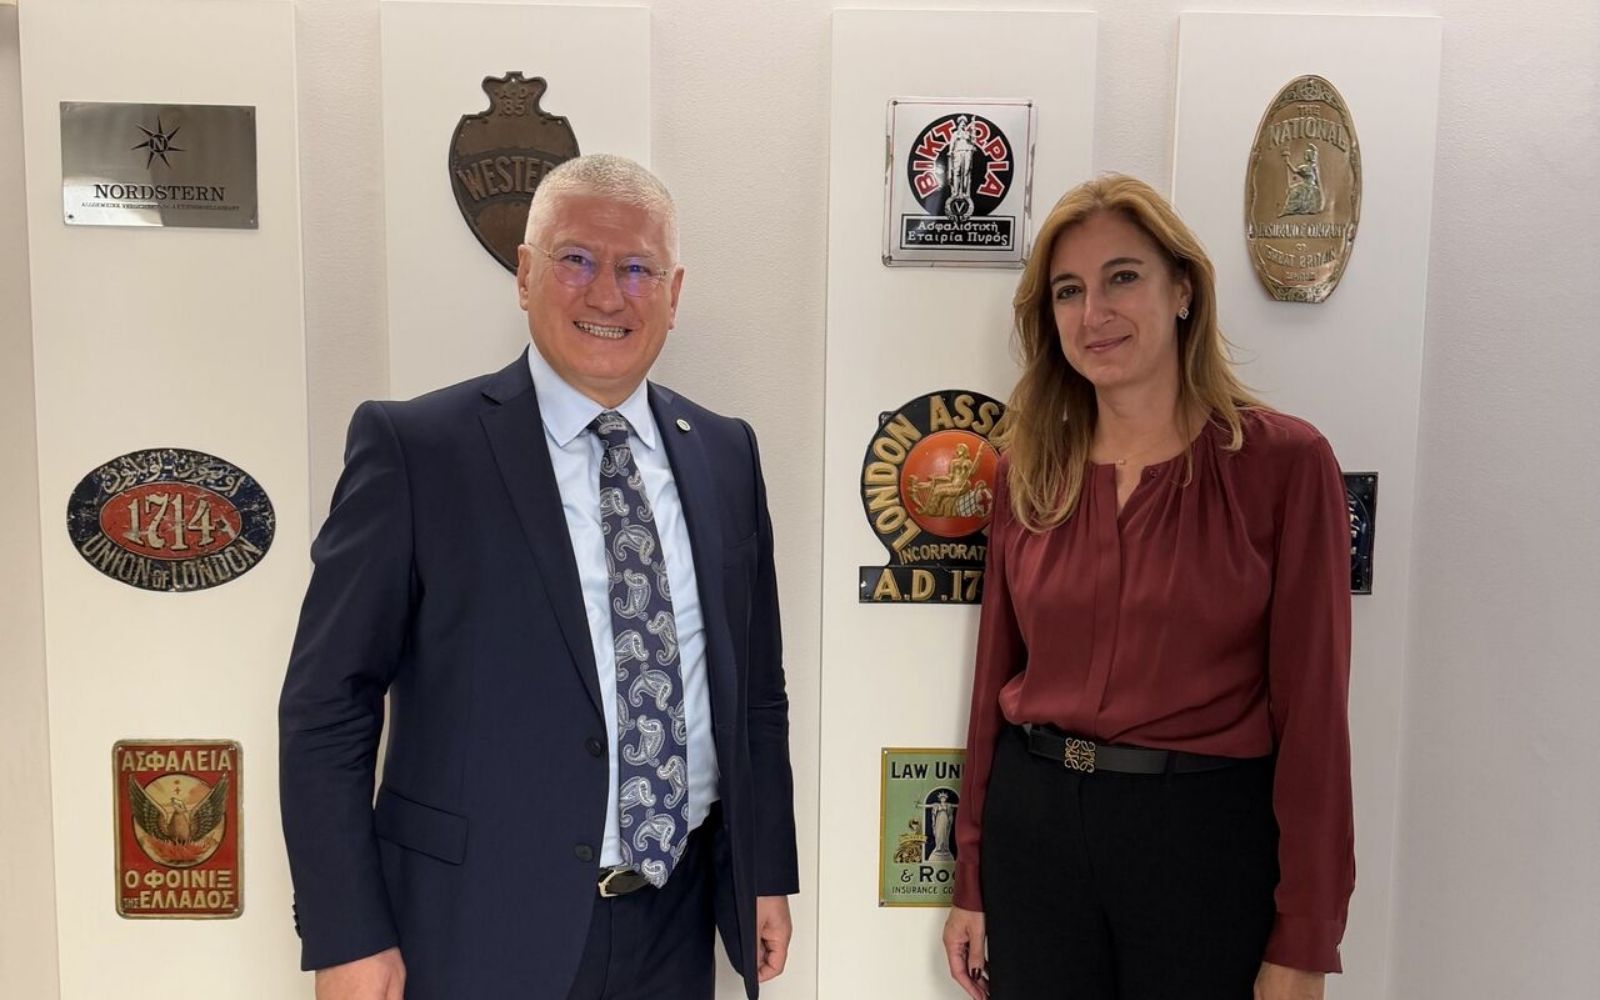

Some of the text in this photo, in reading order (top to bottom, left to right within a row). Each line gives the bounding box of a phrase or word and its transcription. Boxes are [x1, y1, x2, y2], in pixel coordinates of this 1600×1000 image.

[1296, 105, 1320, 117] THE
[1269, 117, 1347, 151] NATIONAL
[94, 183, 226, 201] NORDSTERN
[907, 231, 1008, 246] Εταιρία Πυρός
[864, 413, 923, 551] LONDON
[122, 493, 215, 550] 1714
[81, 534, 265, 590] UNION OF LONDON
[122, 750, 232, 772] ΑΣΦΑΛΕΙΑ
[891, 761, 928, 779] LAW
[144, 869, 232, 888] ΦΟΙΝΙΞ
[900, 868, 913, 883] &
[139, 890, 234, 909] ΕΛΛΑΔΟΣ
[892, 885, 937, 895] INSURANCE
